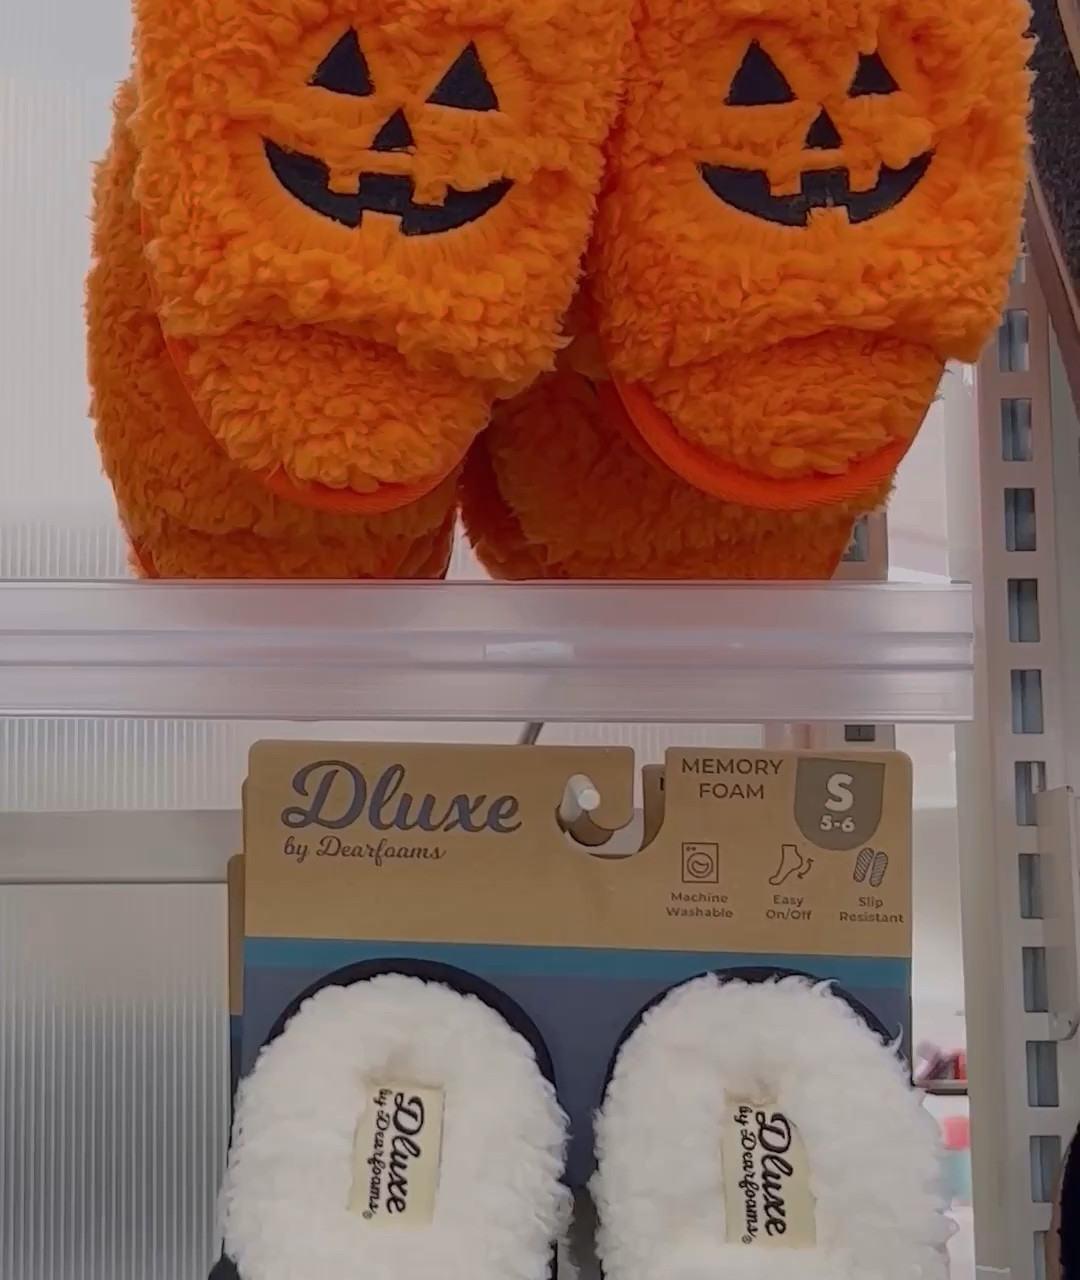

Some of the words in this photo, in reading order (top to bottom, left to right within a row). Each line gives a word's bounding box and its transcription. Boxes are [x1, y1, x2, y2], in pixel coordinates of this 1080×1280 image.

[681, 757, 784, 776] MEMORY
[281, 760, 522, 834] Dluxe
[699, 782, 765, 800] FOAM
[824, 773, 854, 813] S
[820, 815, 856, 832] 5-6
[284, 837, 308, 864] by
[316, 836, 446, 867] Dearfoams
[670, 892, 728, 903] Machine
[773, 895, 804, 907] Easy
[858, 896, 883, 909] Slip
[666, 907, 733, 919] Washable
[765, 909, 812, 920] On/Off
[839, 911, 904, 924] Resistant
[374, 1088, 393, 1109] by
[733, 1105, 751, 1126] by
[386, 1089, 425, 1214] Dluxe
[755, 1111, 793, 1237] Dluxe
